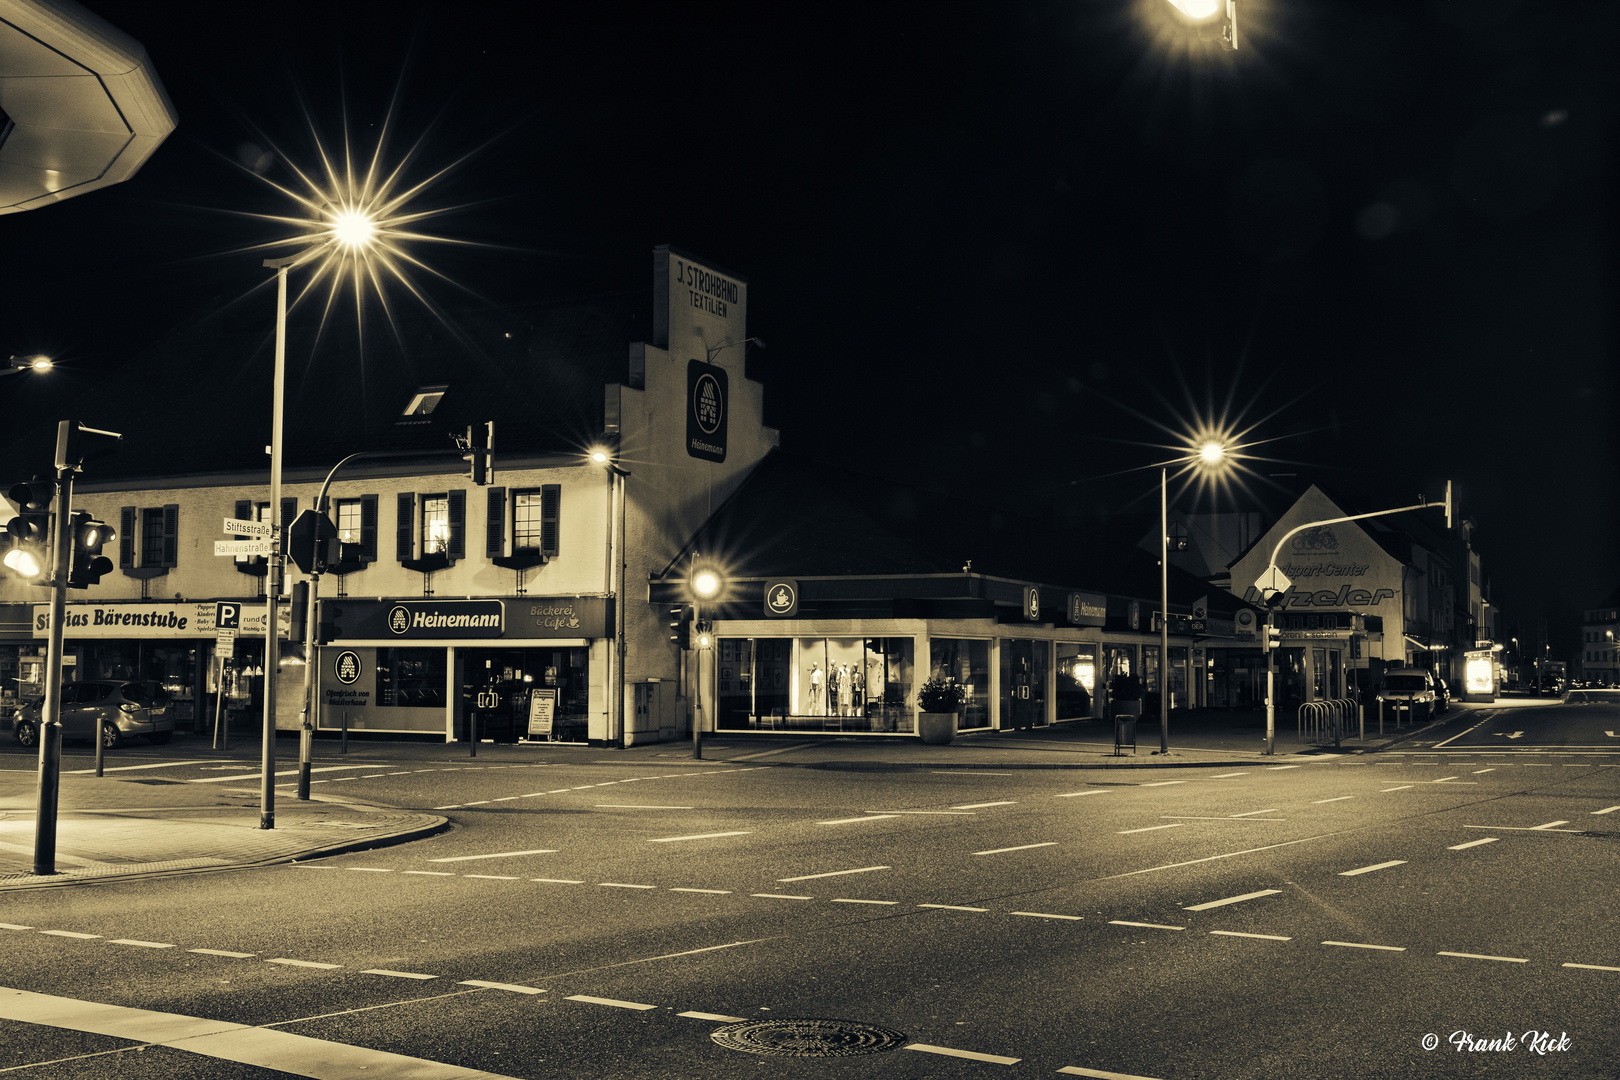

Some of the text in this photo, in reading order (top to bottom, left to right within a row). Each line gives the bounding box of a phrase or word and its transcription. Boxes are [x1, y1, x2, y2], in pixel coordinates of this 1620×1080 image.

[677, 261, 738, 305] J. STROHBAND
[691, 437, 723, 455] Heinemann
[226, 521, 270, 535] Stiftsstraße
[215, 542, 269, 553] Hahnenstraße
[1277, 561, 1369, 579] dsport-Center
[220, 606, 235, 626] P
[530, 604, 573, 617] Bäckerei
[1081, 602, 1105, 617] Heinemann
[36, 608, 188, 631] Siias Bärenstube
[412, 611, 499, 628] Heinemann
[544, 616, 565, 631] Café
[326, 689, 357, 698] Ofenfrisch
